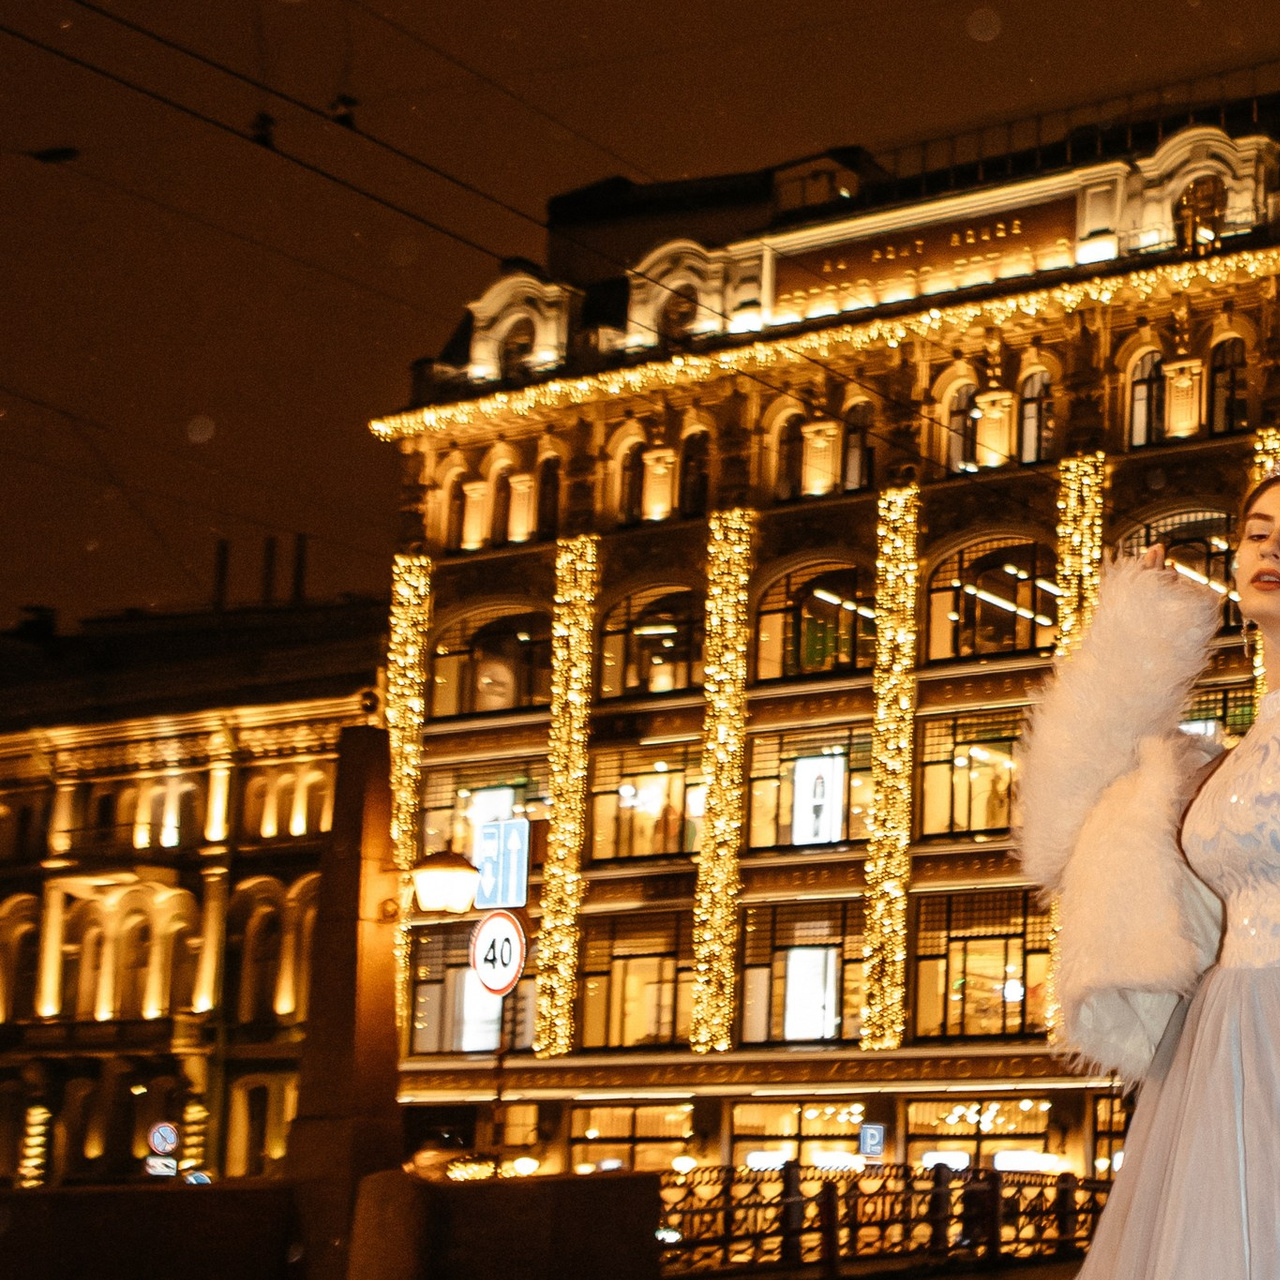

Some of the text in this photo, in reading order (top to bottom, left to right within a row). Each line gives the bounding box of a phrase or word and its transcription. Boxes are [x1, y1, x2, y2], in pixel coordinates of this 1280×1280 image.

[952, 220, 1022, 247] ROUGE
[483, 937, 512, 969] 40
[867, 1129, 879, 1152] P
